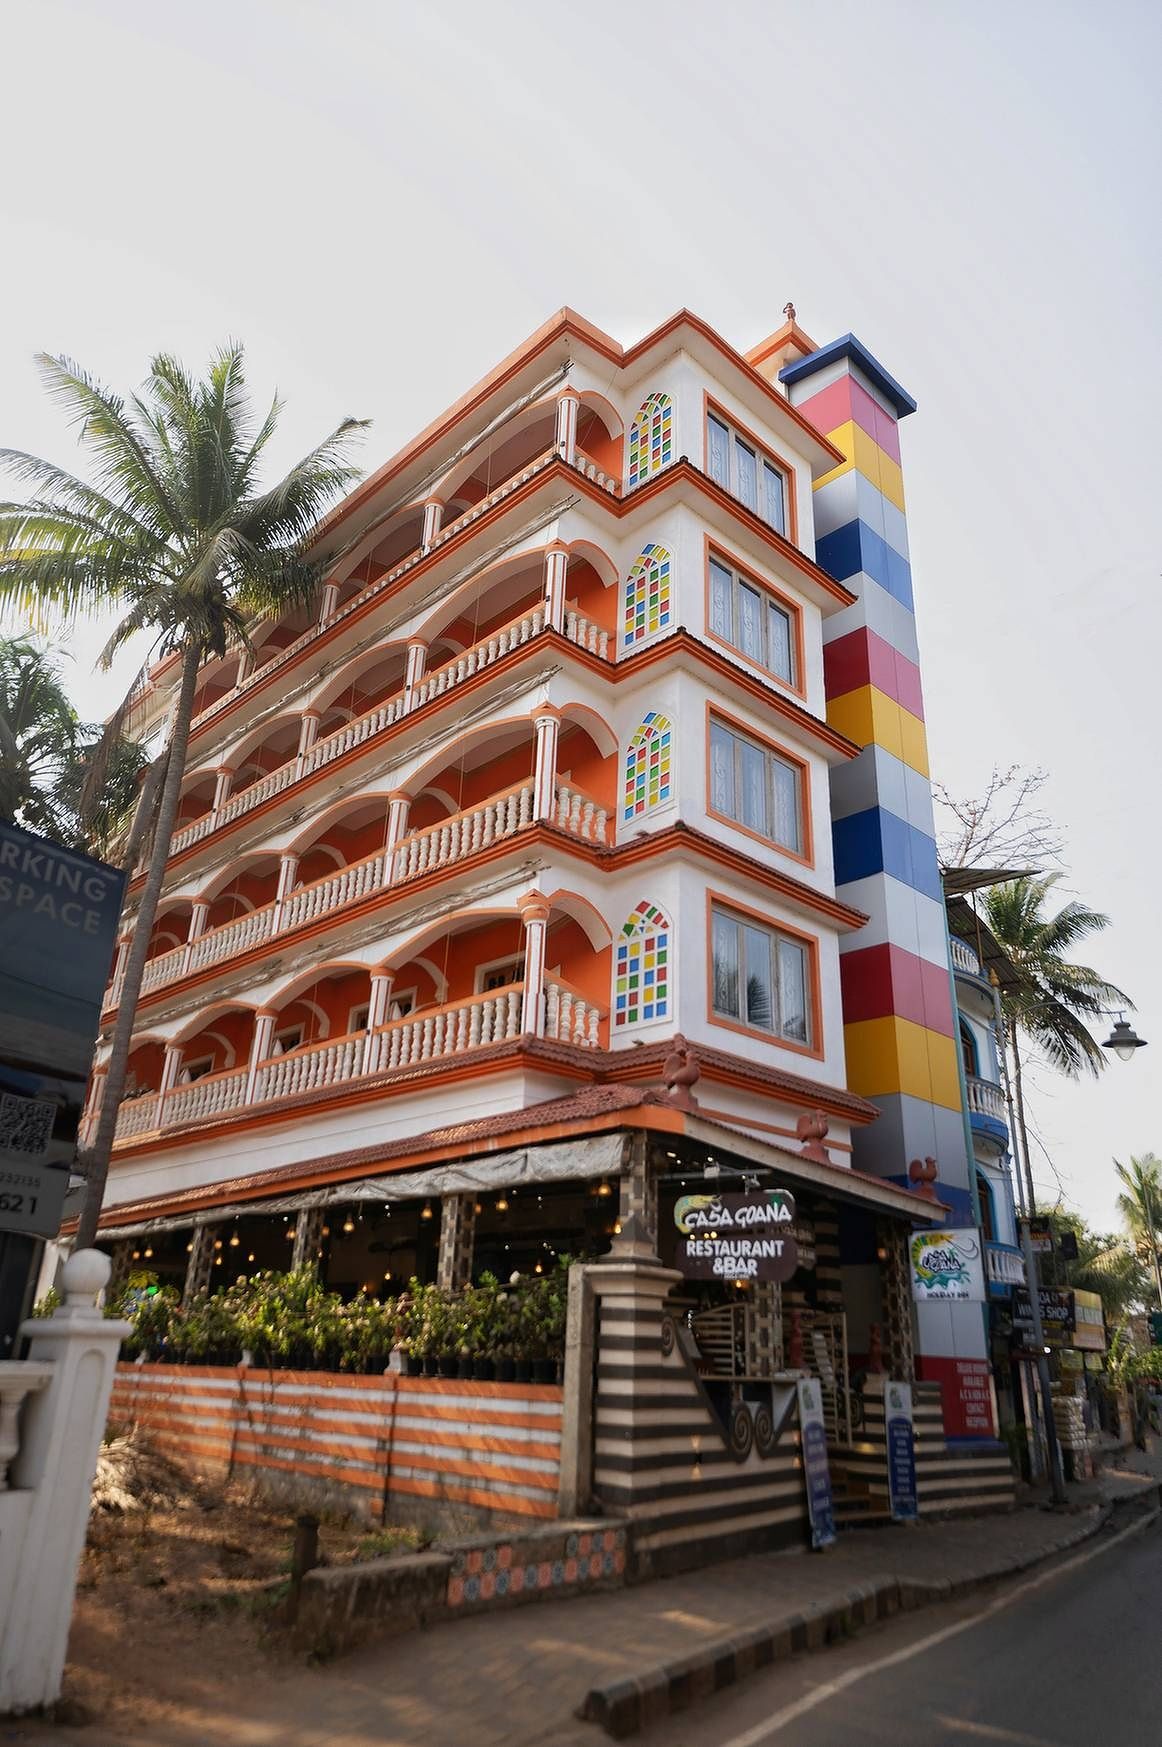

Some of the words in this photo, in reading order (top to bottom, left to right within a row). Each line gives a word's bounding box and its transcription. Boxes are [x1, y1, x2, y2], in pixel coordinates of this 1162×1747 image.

[0, 840, 107, 902] RKING
[0, 876, 101, 935] SPACE
[685, 1202, 733, 1228] CASA
[735, 1202, 792, 1228] GOANA
[686, 1240, 785, 1258] RESTAURANT
